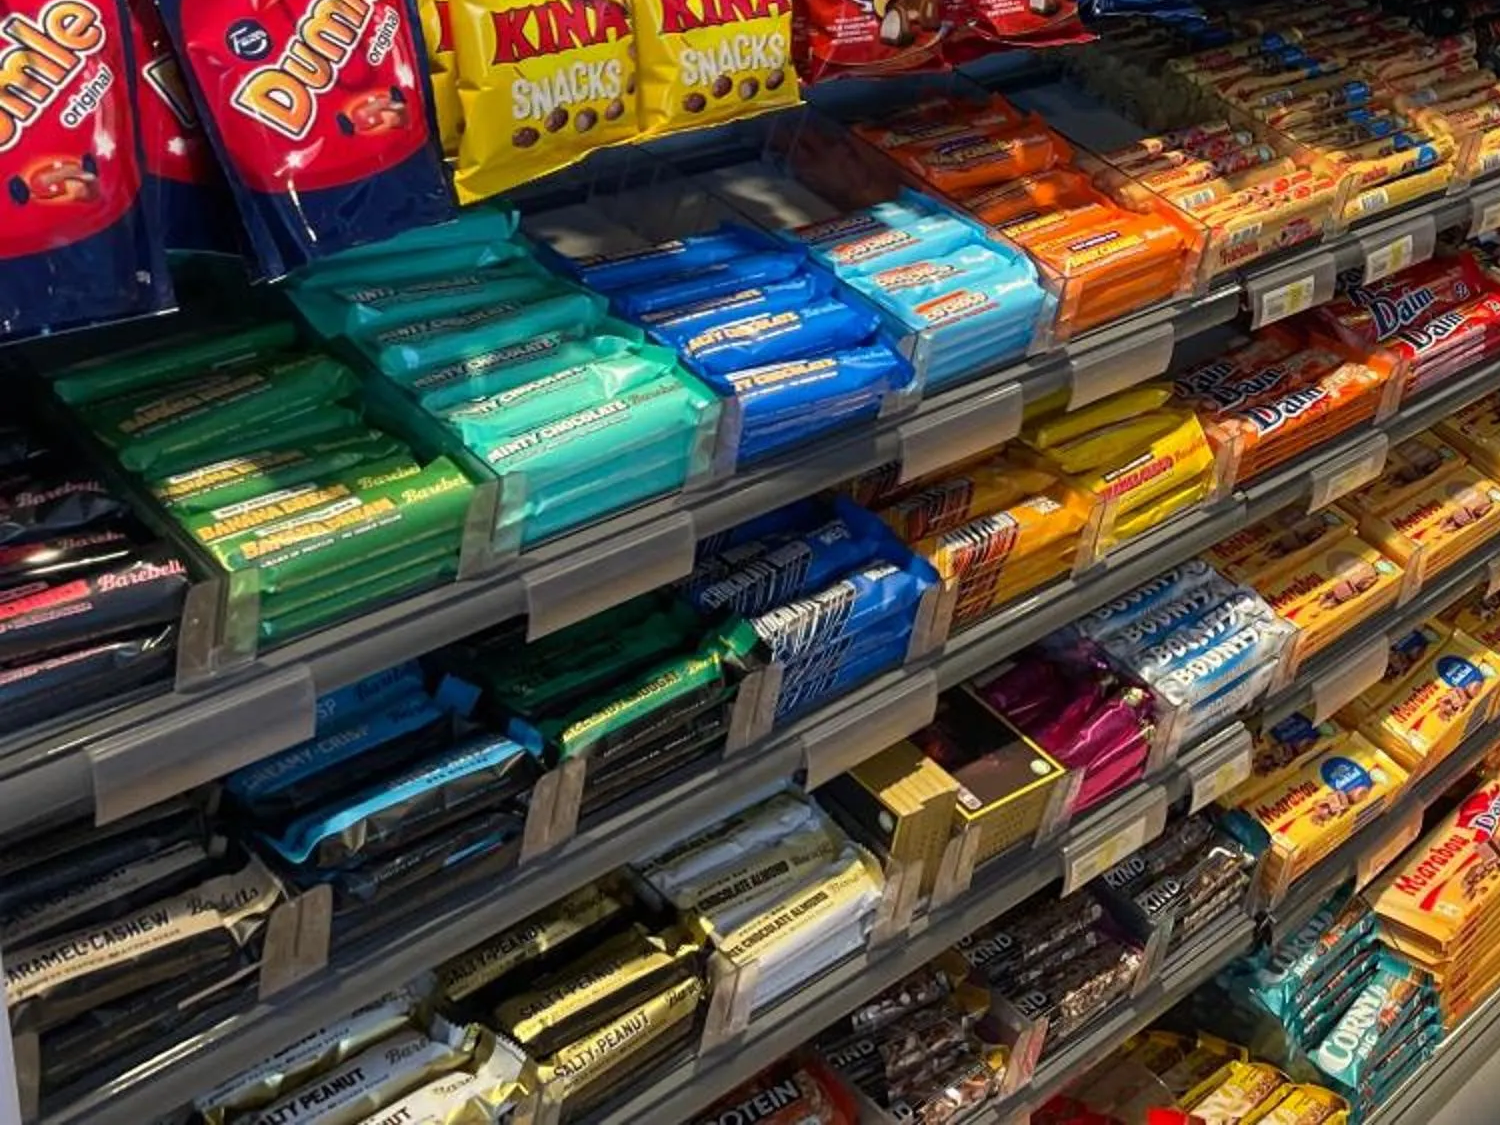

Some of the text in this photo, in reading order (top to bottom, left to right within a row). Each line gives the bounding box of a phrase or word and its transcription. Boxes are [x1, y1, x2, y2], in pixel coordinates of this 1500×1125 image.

[367, 6, 400, 67] original
[680, 32, 786, 86] SNACKS
[60, 65, 114, 129] original
[511, 58, 624, 120] SNACKS
[1371, 286, 1436, 342] Daim
[1401, 310, 1467, 352] Daim
[487, 398, 628, 464] MINTY CHOCOLATE
[1248, 386, 1328, 437] Daim
[1171, 626, 1260, 686] BOUNTY
[1255, 779, 1320, 825] Marabou
[1102, 856, 1147, 890] KIND
[1393, 834, 1470, 896] Marabou
[1140, 878, 1183, 913] KIND
[966, 933, 1014, 966] KIND
[1357, 1029, 1379, 1059] BIG
[301, 1067, 367, 1110] PEANUT
